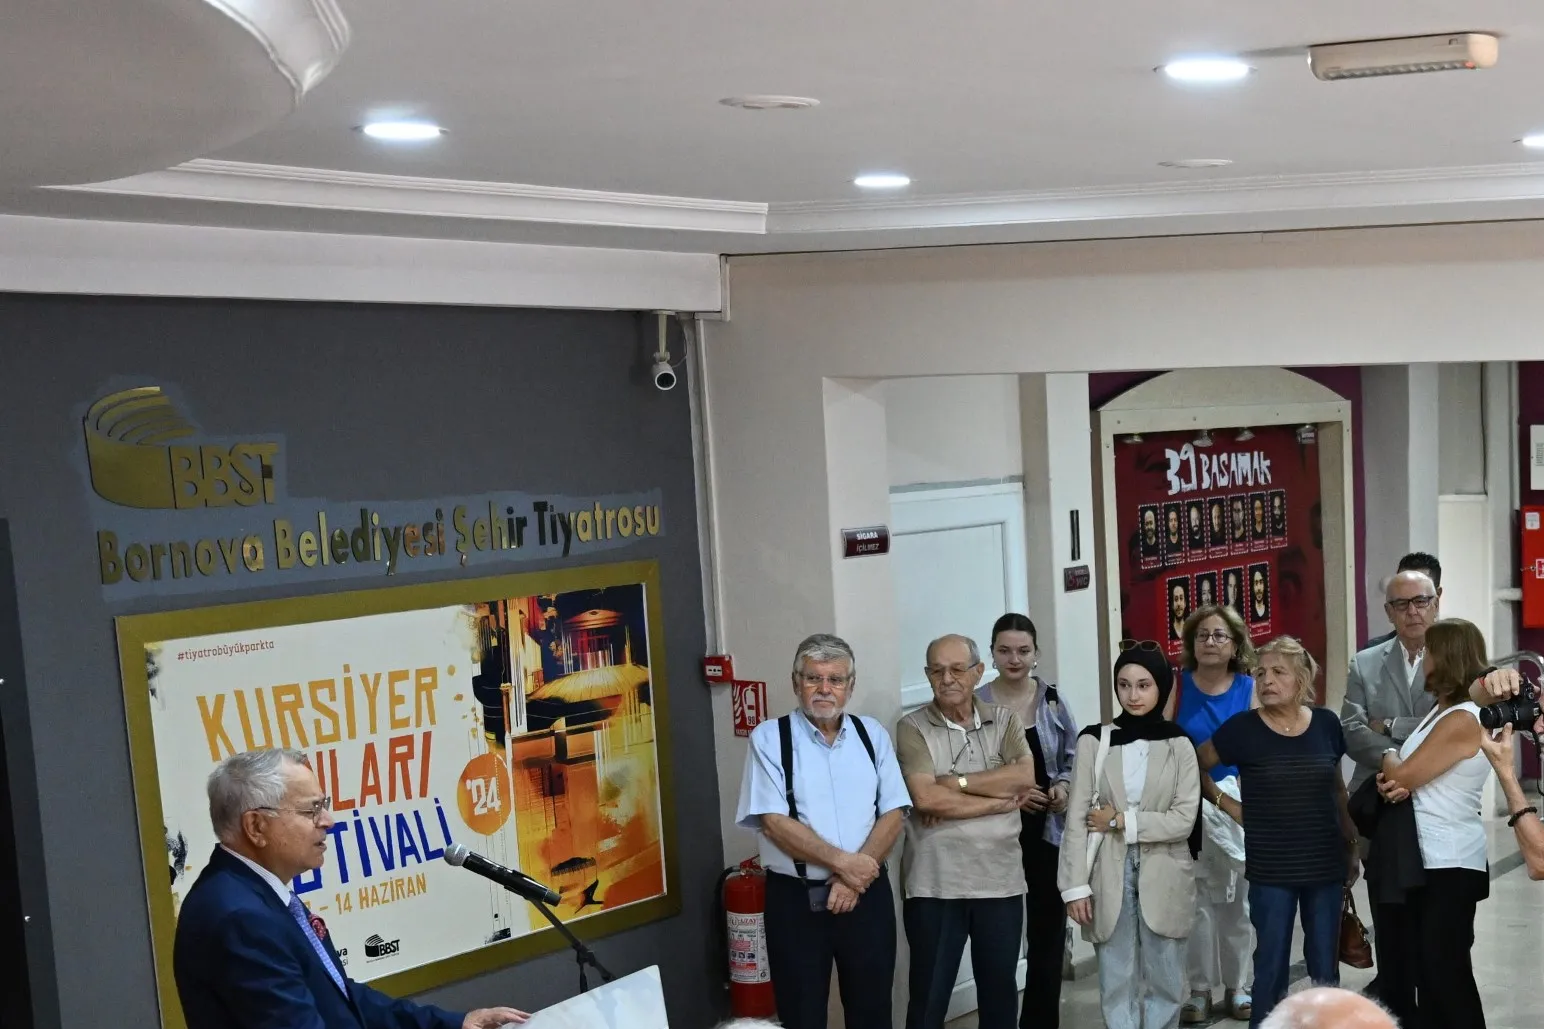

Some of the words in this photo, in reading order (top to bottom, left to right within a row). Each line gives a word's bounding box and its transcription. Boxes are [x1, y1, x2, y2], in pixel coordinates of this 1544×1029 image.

[168, 442, 279, 509] BBST
[1165, 442, 1198, 495] 39
[1200, 450, 1272, 490] BASAMAK
[97, 529, 266, 585] Bornova
[273, 508, 446, 576] Belediyesi
[453, 500, 528, 568] Şehir
[533, 500, 660, 558] Tiyatrosu
[856, 530, 879, 540] SİGARA
[856, 543, 880, 554] İÇİLMEZ
[177, 640, 275, 661] #tiyatrobüyükparkta
[196, 664, 438, 763] KURSİYER
[747, 715, 756, 725] 98
[335, 892, 353, 916] 14
[358, 872, 428, 910] HAZİRAN
[379, 938, 401, 957] BBST
